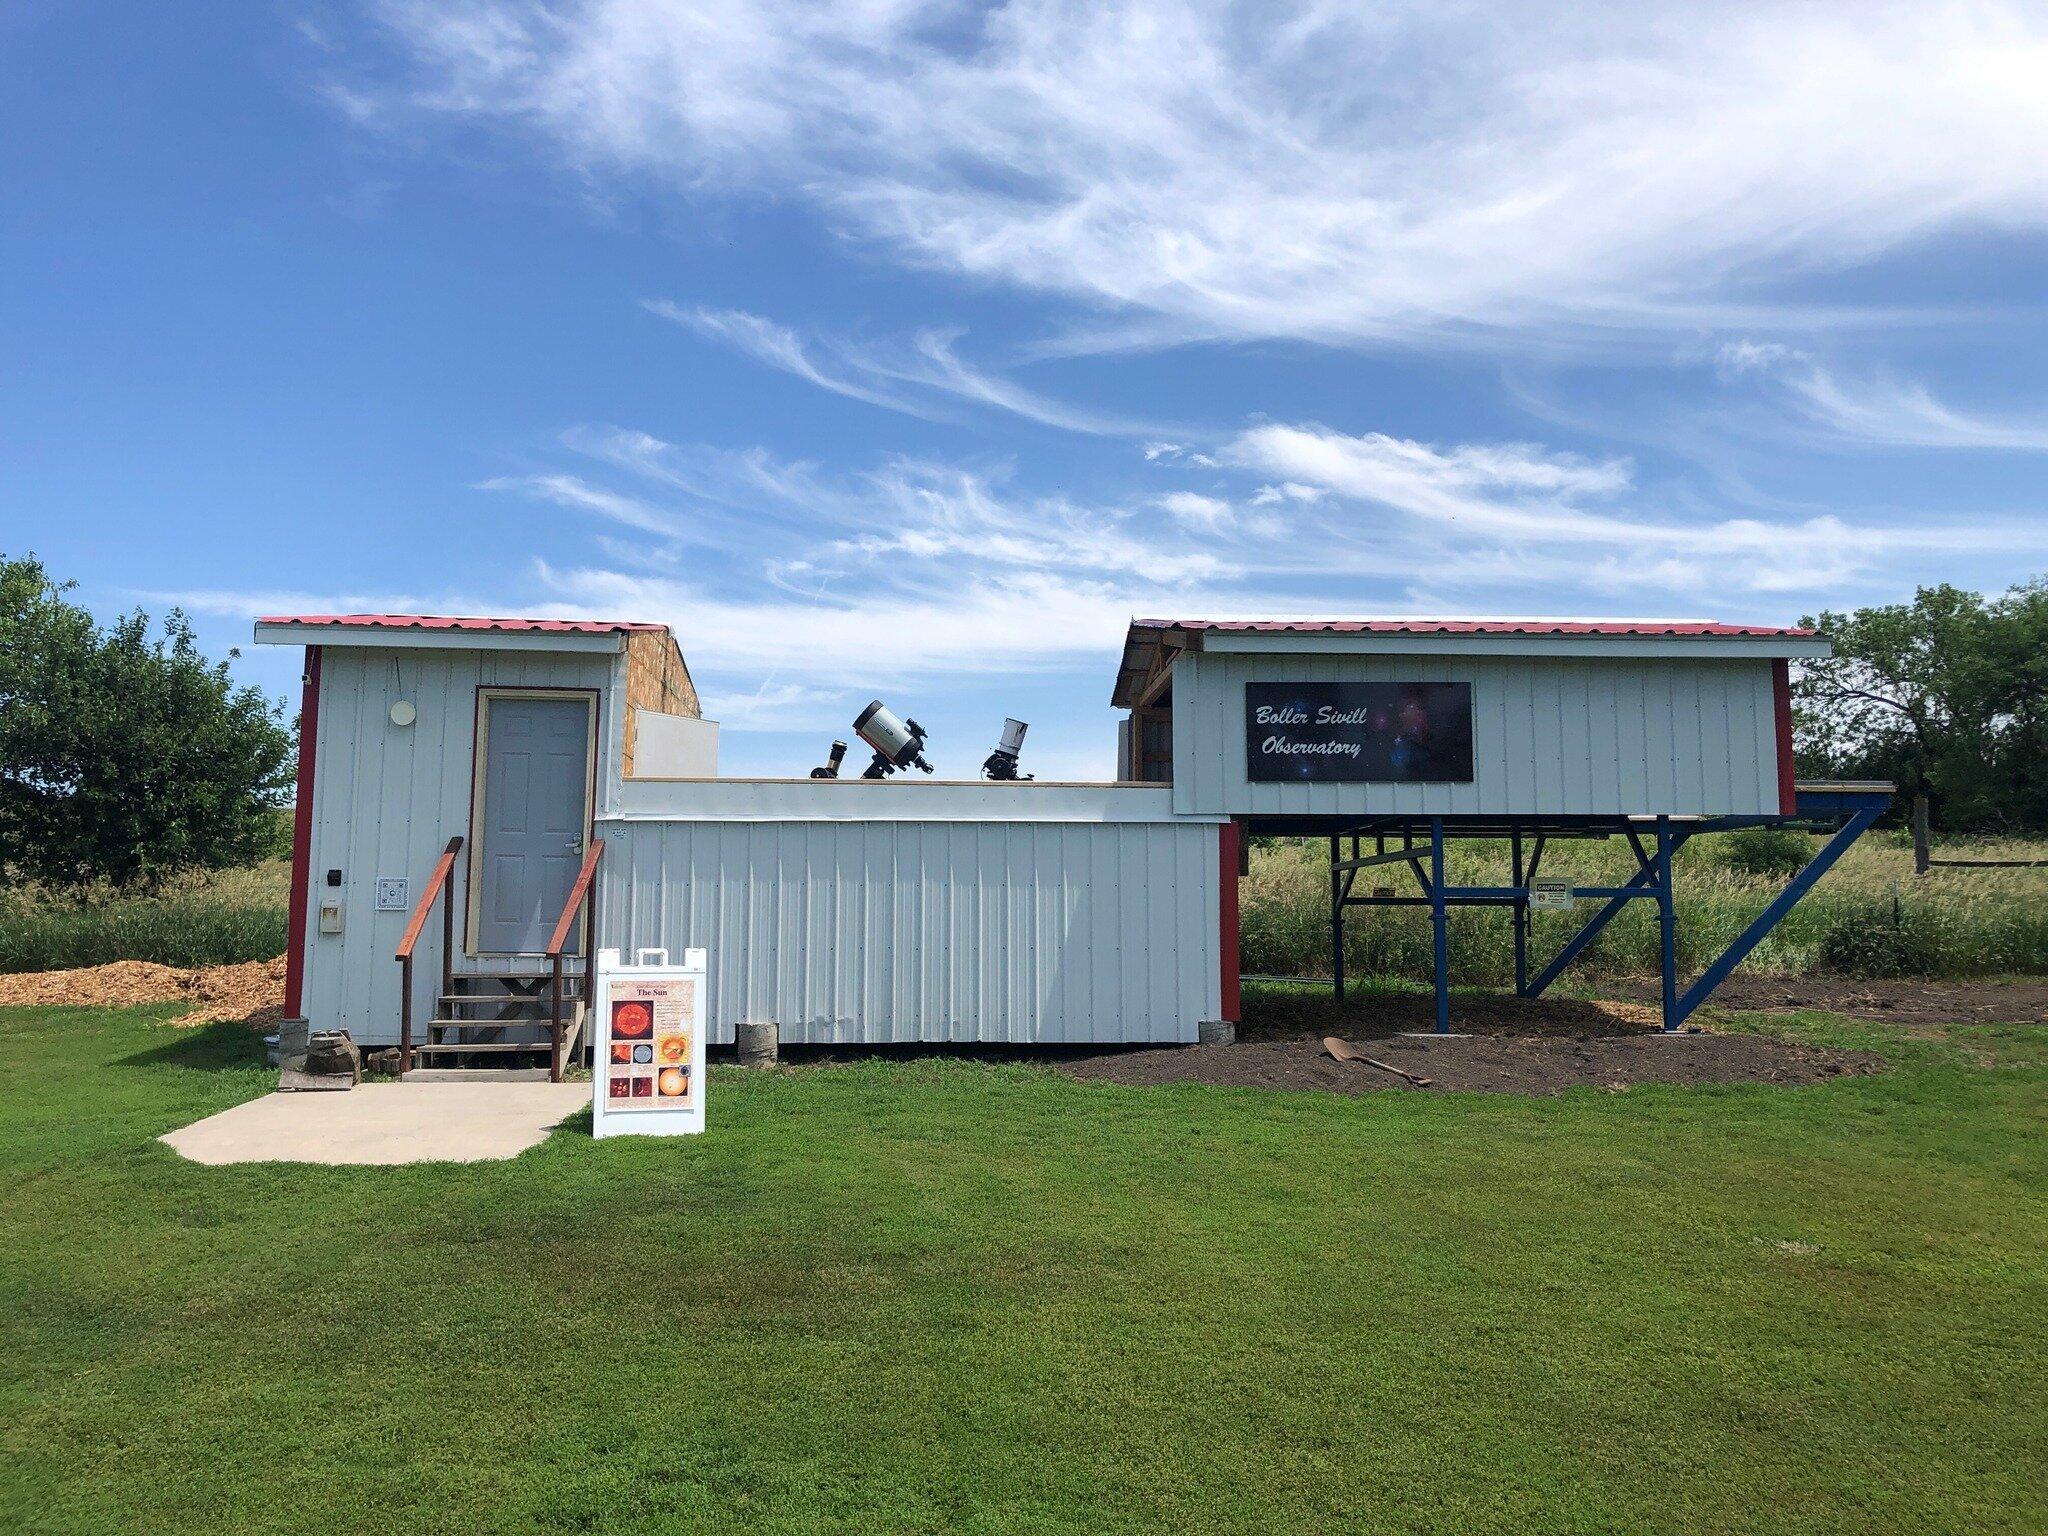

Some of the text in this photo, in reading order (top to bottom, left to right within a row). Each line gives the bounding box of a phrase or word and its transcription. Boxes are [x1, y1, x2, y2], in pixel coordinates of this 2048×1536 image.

[1255, 705, 1367, 725] Boller Sivill
[1261, 735, 1362, 759] Observatory
[637, 988, 668, 996] The Sun
